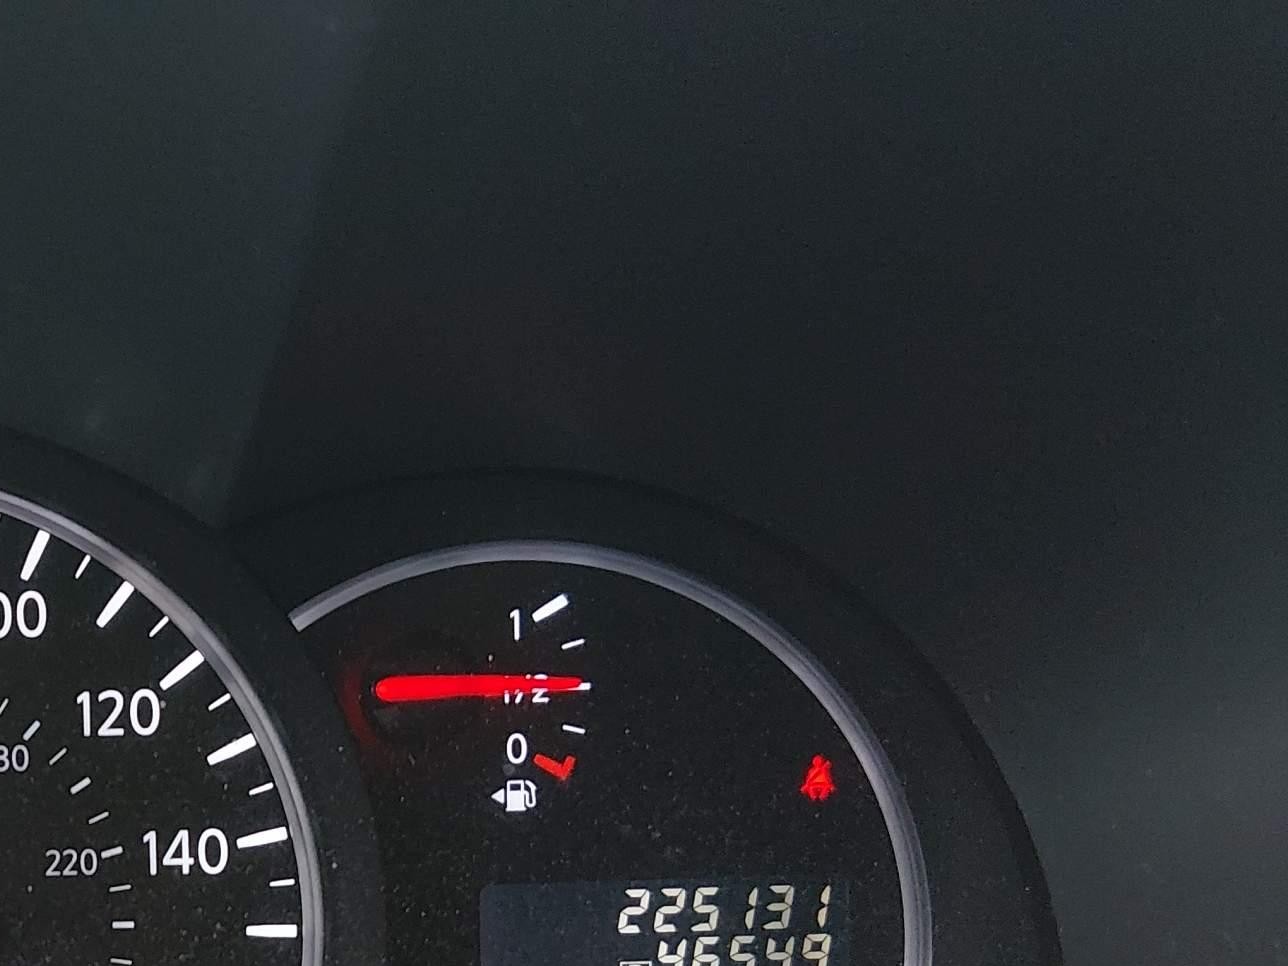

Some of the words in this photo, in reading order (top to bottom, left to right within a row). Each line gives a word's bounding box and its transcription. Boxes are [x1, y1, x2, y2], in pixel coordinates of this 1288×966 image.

[509, 608, 522, 641] 1
[76, 688, 161, 737] 120
[506, 732, 527, 765] 0
[45, 848, 98, 877] 220
[142, 827, 229, 876] 140
[617, 885, 831, 933] 225131
